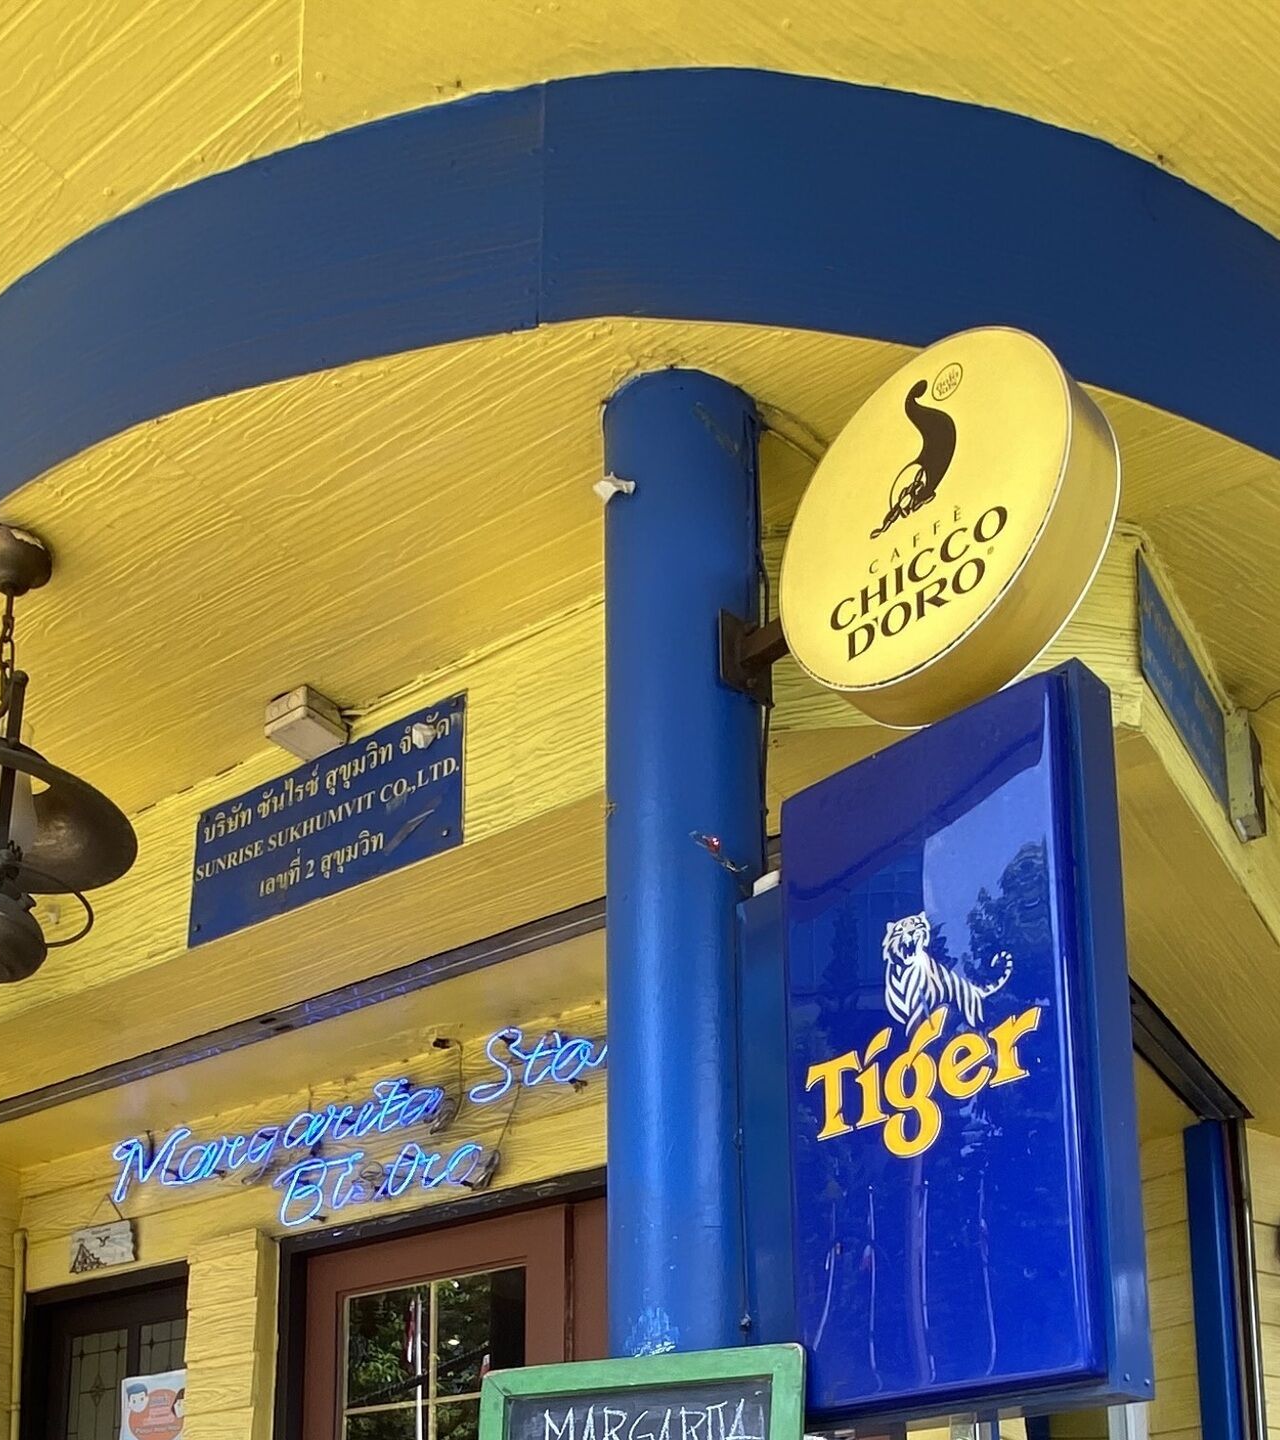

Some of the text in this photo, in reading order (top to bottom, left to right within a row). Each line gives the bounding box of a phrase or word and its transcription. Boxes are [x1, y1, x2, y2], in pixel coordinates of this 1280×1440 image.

[830, 506, 1008, 631] CHICCO
[869, 505, 962, 574] CAFFÈ
[847, 557, 986, 662] D'ORO
[195, 840, 264, 882] SUNRISE
[267, 791, 375, 852] SUKHUMVIT
[204, 803, 253, 844] บริษัท
[325, 741, 393, 796] สุขุมวิท
[258, 829, 384, 898] เลขที่ 2 สุขุมวิท
[112, 1026, 607, 1203] Margarita Sto
[806, 1003, 1042, 1159] Tiger
